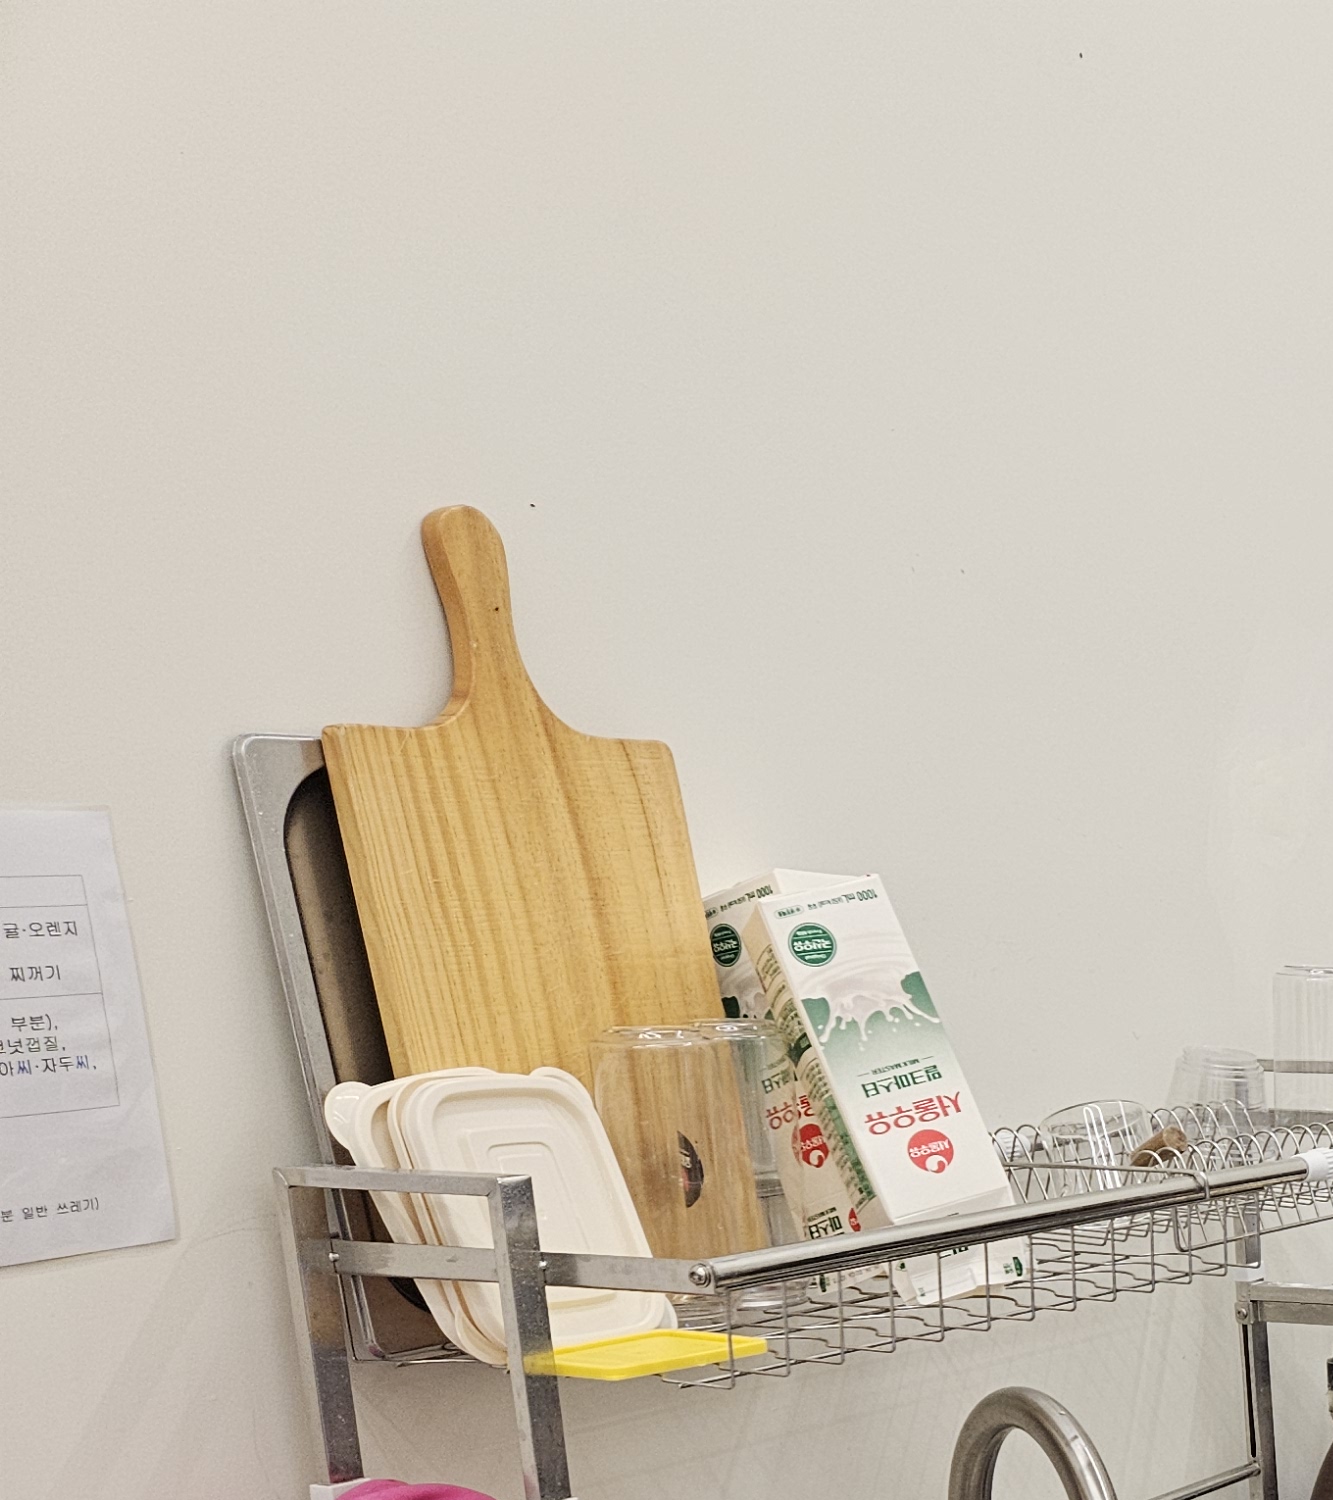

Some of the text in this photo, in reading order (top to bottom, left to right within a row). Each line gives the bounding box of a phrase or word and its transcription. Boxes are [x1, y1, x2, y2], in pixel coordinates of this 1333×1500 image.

[856, 889, 878, 902] 1000
[8, 964, 62, 982] 찌꺼기
[11, 1013, 58, 1032] 부분),
[860, 1064, 944, 1098] 밀크마스터
[863, 1091, 963, 1136] 서울우유
[907, 1136, 951, 1159] 서울우유
[21, 1205, 48, 1220] 일반
